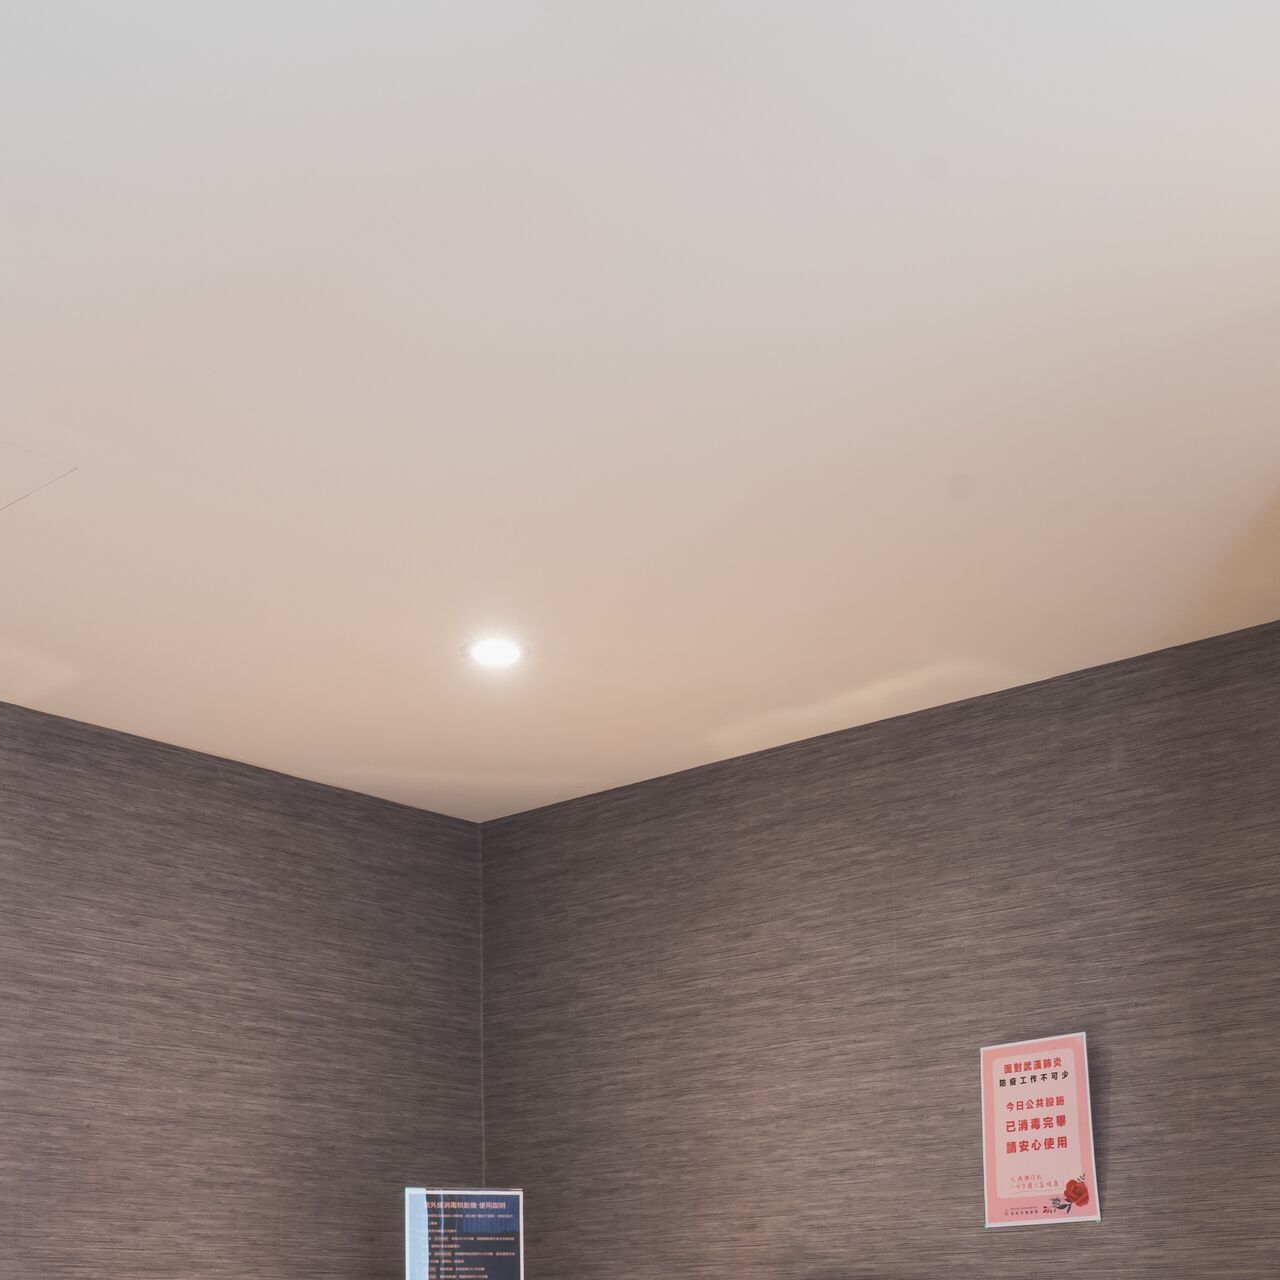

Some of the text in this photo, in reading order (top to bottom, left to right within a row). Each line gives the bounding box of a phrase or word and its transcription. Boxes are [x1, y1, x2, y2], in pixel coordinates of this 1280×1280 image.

[999, 1071, 1069, 1087] 防疫工作不可少
[1006, 1096, 1065, 1112] 今日公共設施
[1006, 1136, 1068, 1154] 請安心使用
